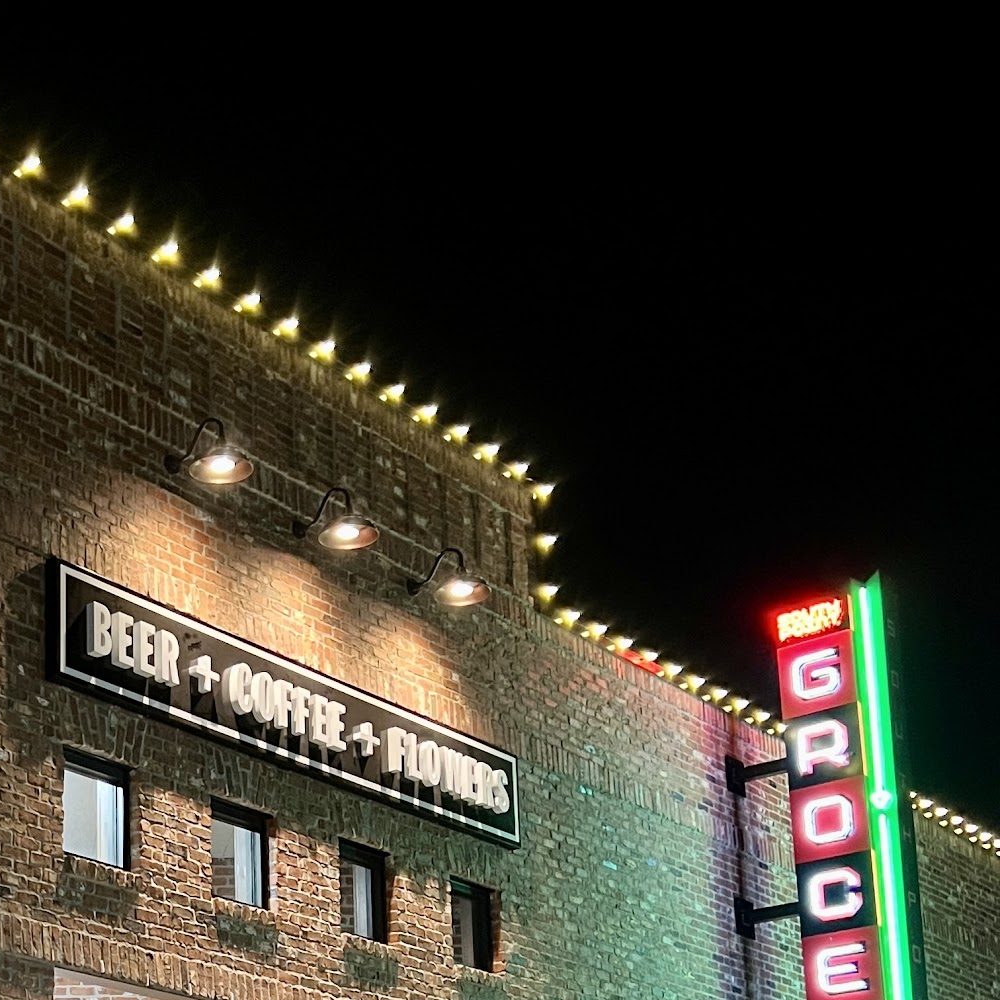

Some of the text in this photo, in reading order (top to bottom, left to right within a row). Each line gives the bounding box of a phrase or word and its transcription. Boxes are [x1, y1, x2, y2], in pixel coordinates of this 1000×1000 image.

[86, 600, 180, 688] BEER
[222, 662, 347, 752] COFFEE
[381, 726, 510, 815] FLOWERS
